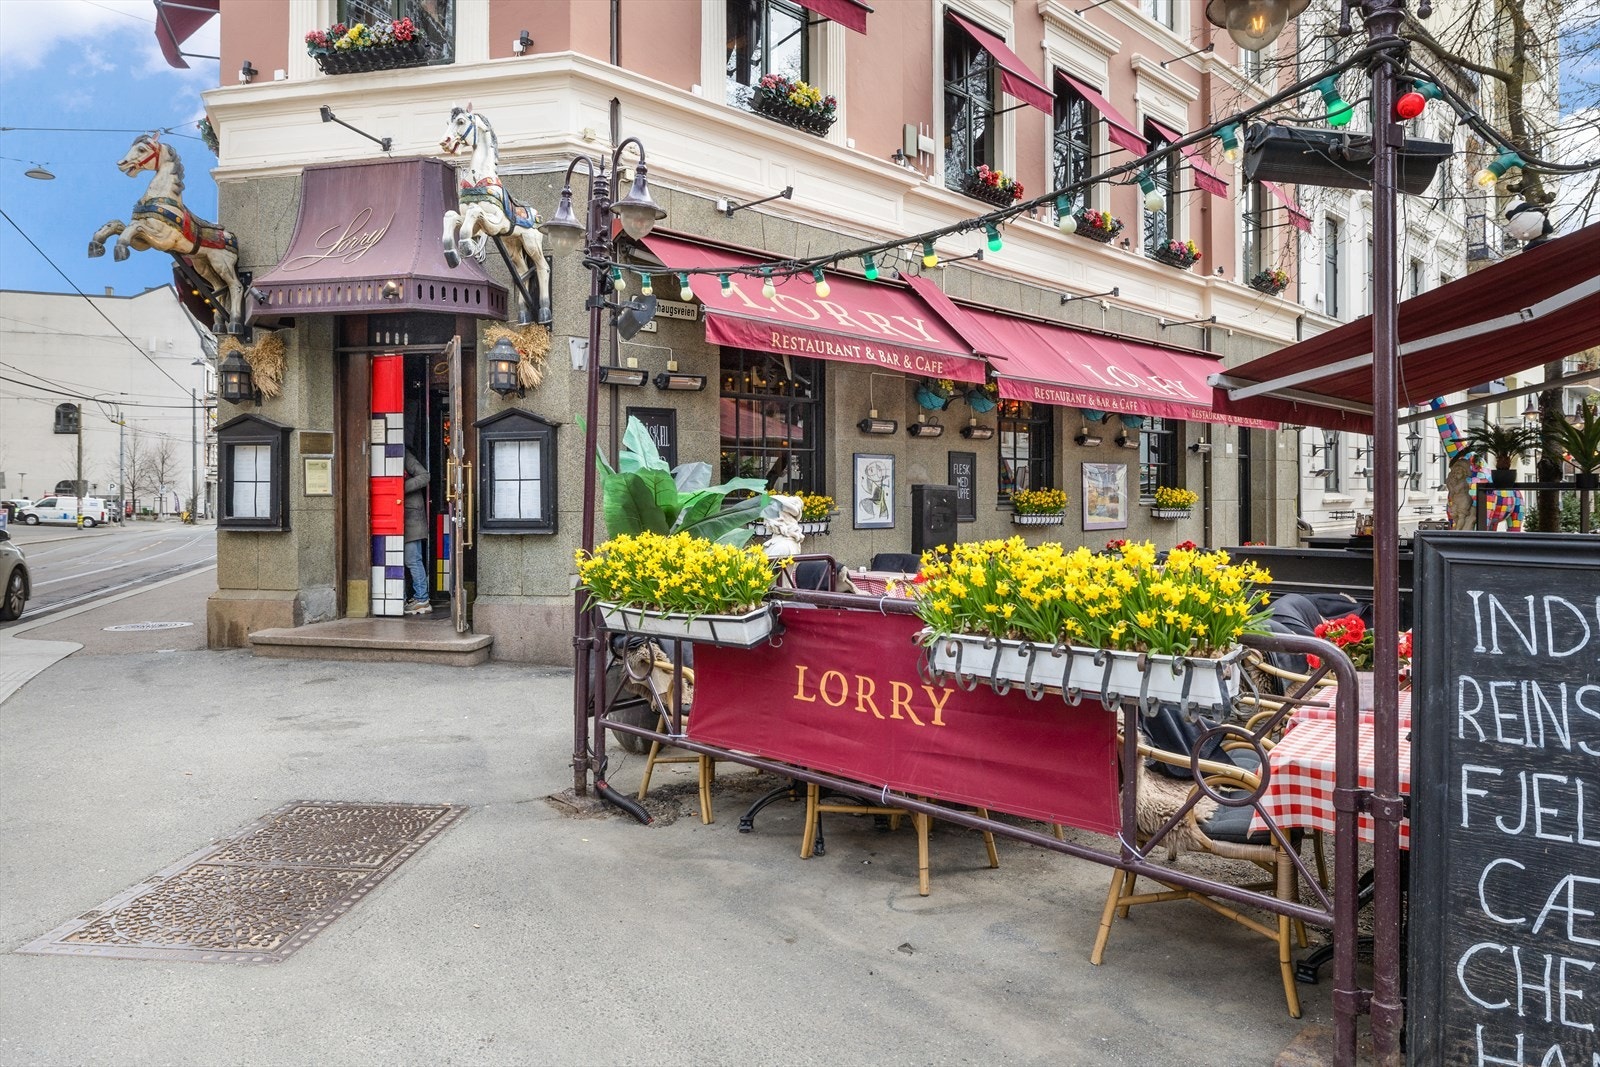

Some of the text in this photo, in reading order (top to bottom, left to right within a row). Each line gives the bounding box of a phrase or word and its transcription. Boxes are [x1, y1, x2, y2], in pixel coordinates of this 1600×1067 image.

[281, 207, 395, 272] Lorry
[656, 301, 695, 317] haugsveien
[718, 278, 939, 342] LORRY
[772, 331, 943, 373] RESTAURANT & BAR & CAFE
[1034, 386, 1086, 404] RESTAURANT
[1088, 394, 1095, 406] &
[1096, 396, 1111, 408] BAR
[1112, 398, 1118, 409] &
[953, 463, 971, 475] FLESK
[957, 476, 969, 488] MED
[957, 487, 970, 500] UPPE
[1466, 590, 1600, 661] IND
[793, 664, 955, 727] LORRY
[1458, 674, 1600, 757] REINS
[1460, 763, 1600, 848] FJEL
